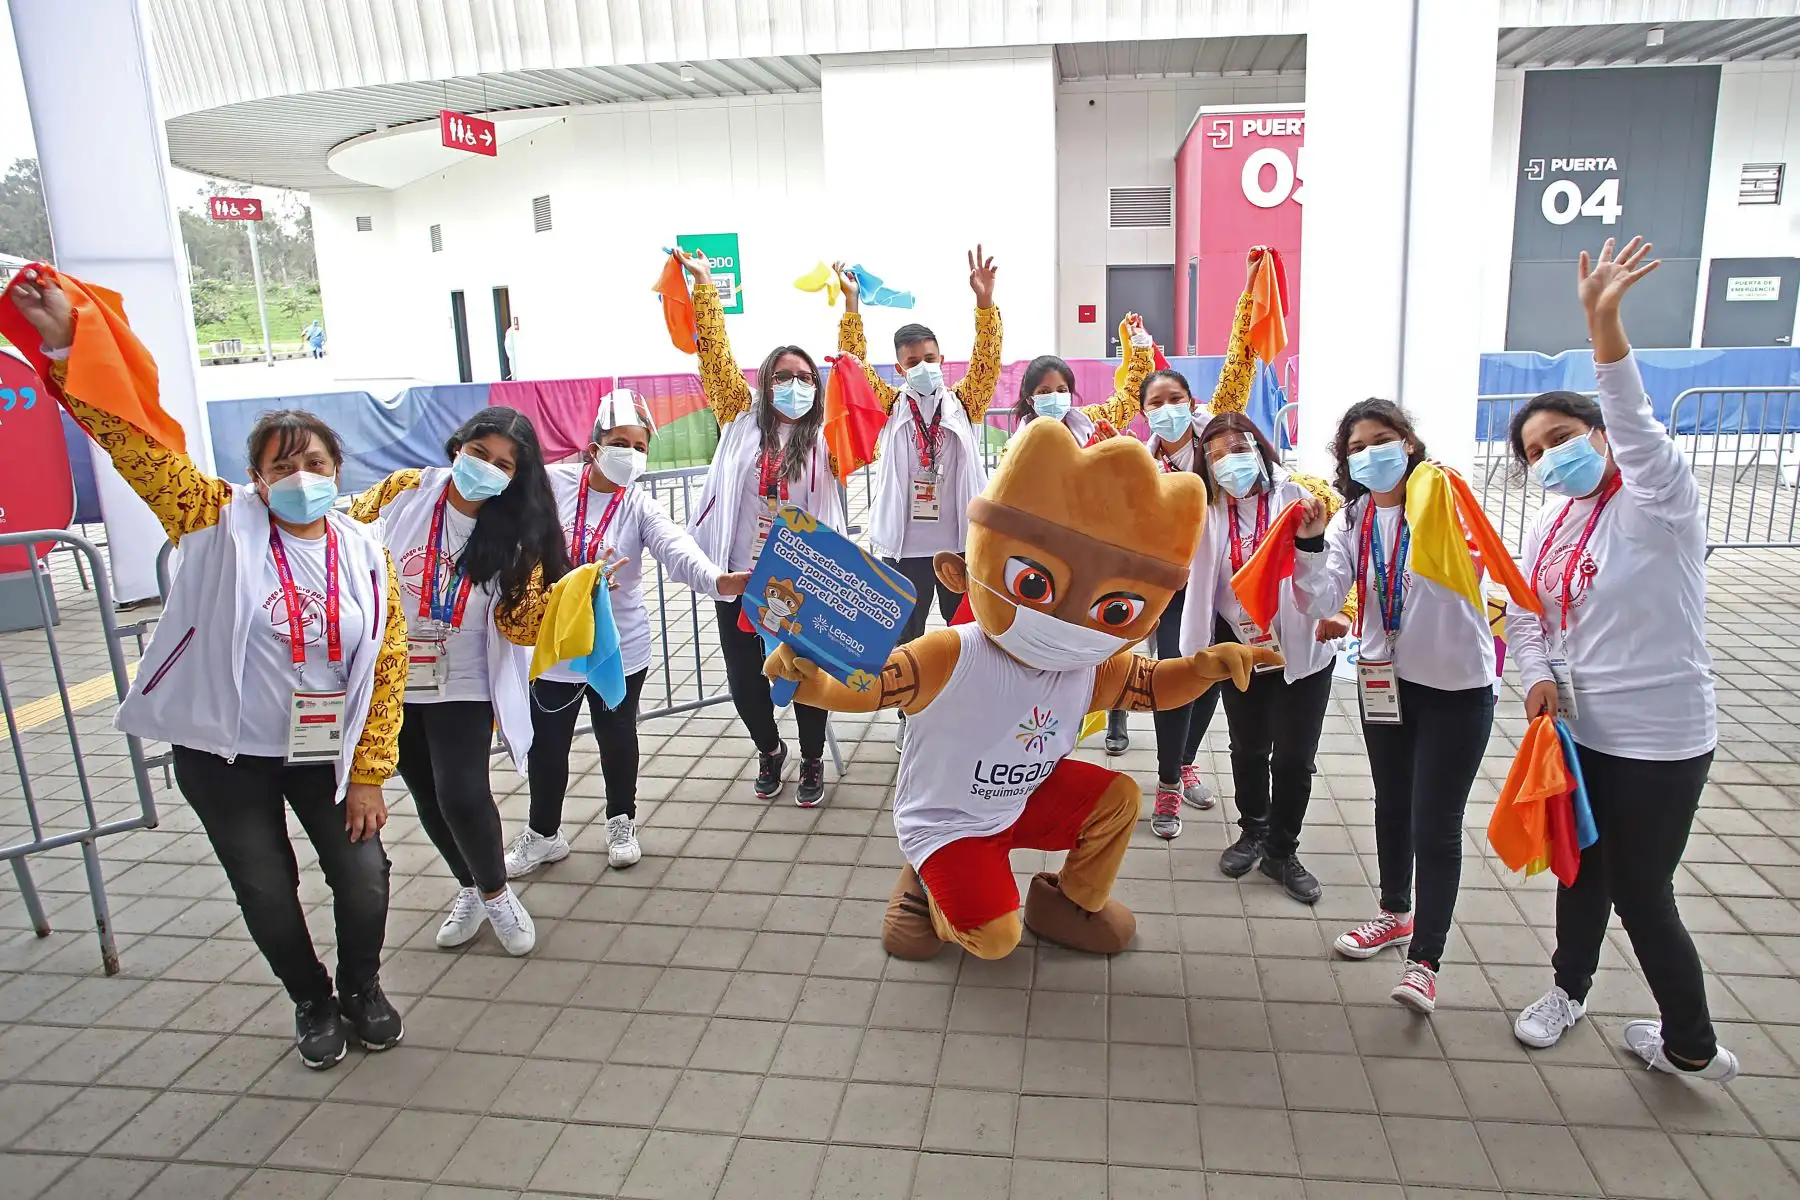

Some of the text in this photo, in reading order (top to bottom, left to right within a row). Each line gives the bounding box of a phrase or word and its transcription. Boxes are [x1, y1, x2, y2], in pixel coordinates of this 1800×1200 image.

[1242, 118, 1305, 137] PUER
[1550, 157, 1618, 172] PUERTA
[1541, 178, 1623, 225] 04
[774, 543, 895, 628] todos ponen el hombro
[779, 528, 901, 619] En las sedes de Legado,
[262, 591, 278, 610] Pongo
[310, 591, 326, 601] por
[797, 577, 857, 621] por el Perú.
[970, 783, 1025, 800] Seguimos
